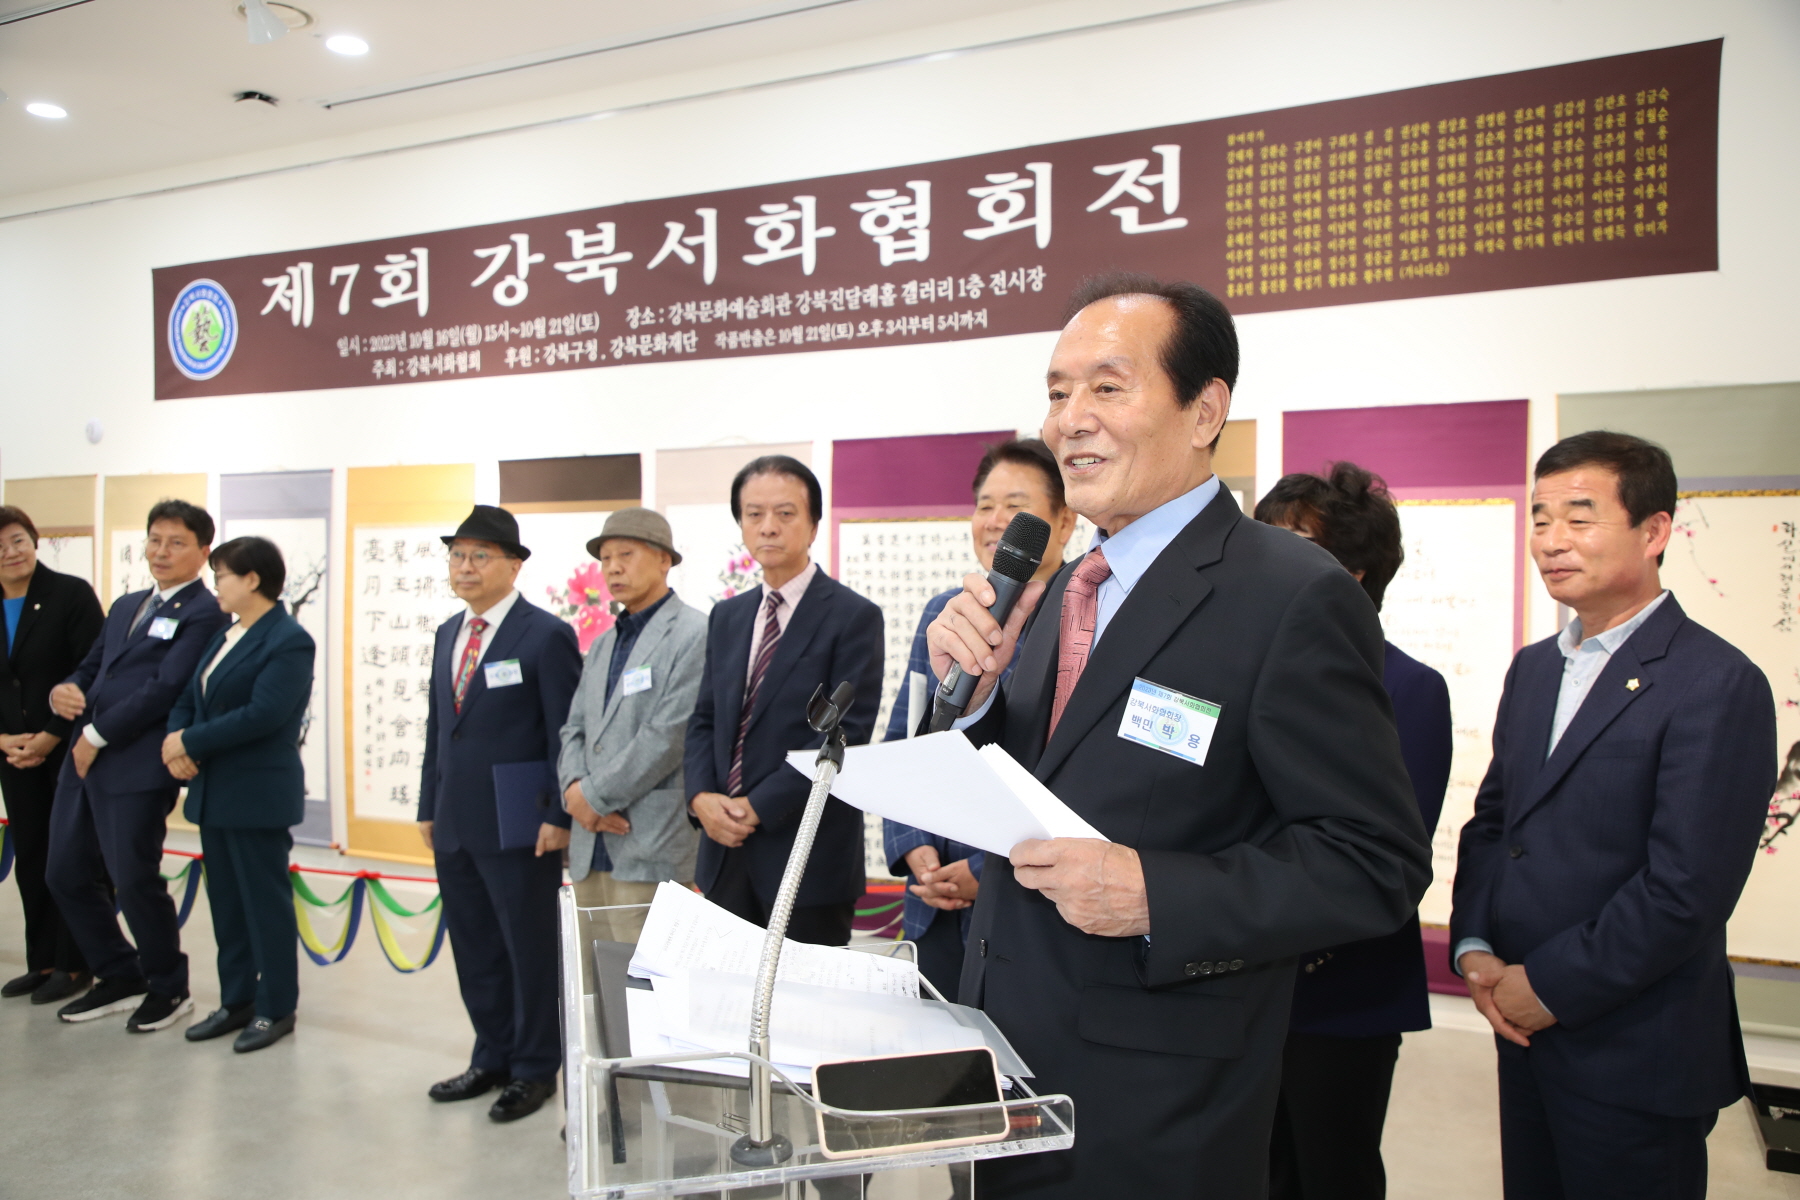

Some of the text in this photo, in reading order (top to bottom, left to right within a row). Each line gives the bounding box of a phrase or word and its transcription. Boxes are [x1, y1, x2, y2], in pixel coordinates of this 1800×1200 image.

[260, 144, 1188, 328] 제7회 강북서화협회전
[337, 335, 361, 357] 일시
[410, 328, 434, 351] 10월
[436, 324, 482, 349] 16일(월)
[549, 311, 599, 339] 21일(토)
[626, 306, 656, 330] 장소
[668, 292, 791, 327] 강북문화예술회관
[795, 283, 897, 317] 강북진달래홀
[901, 276, 954, 305] 갤러리
[958, 273, 985, 300] 1층
[989, 265, 1046, 296] 전시장
[406, 350, 481, 378] 강북서화협회
[504, 343, 531, 369] 후원
[609, 330, 699, 359] 강북문화재단
[779, 322, 804, 345] 10월
[806, 319, 854, 344] 21일(토)
[856, 315, 884, 339] 오후
[886, 311, 935, 336] 3시부터
[937, 308, 988, 332] 5시까지
[1130, 698, 1182, 723] 강북서화협회장
[1138, 684, 1157, 696] 2023년
[1173, 696, 1212, 715] 강북서화협회전
[1131, 714, 1201, 749] 백민 박 용
